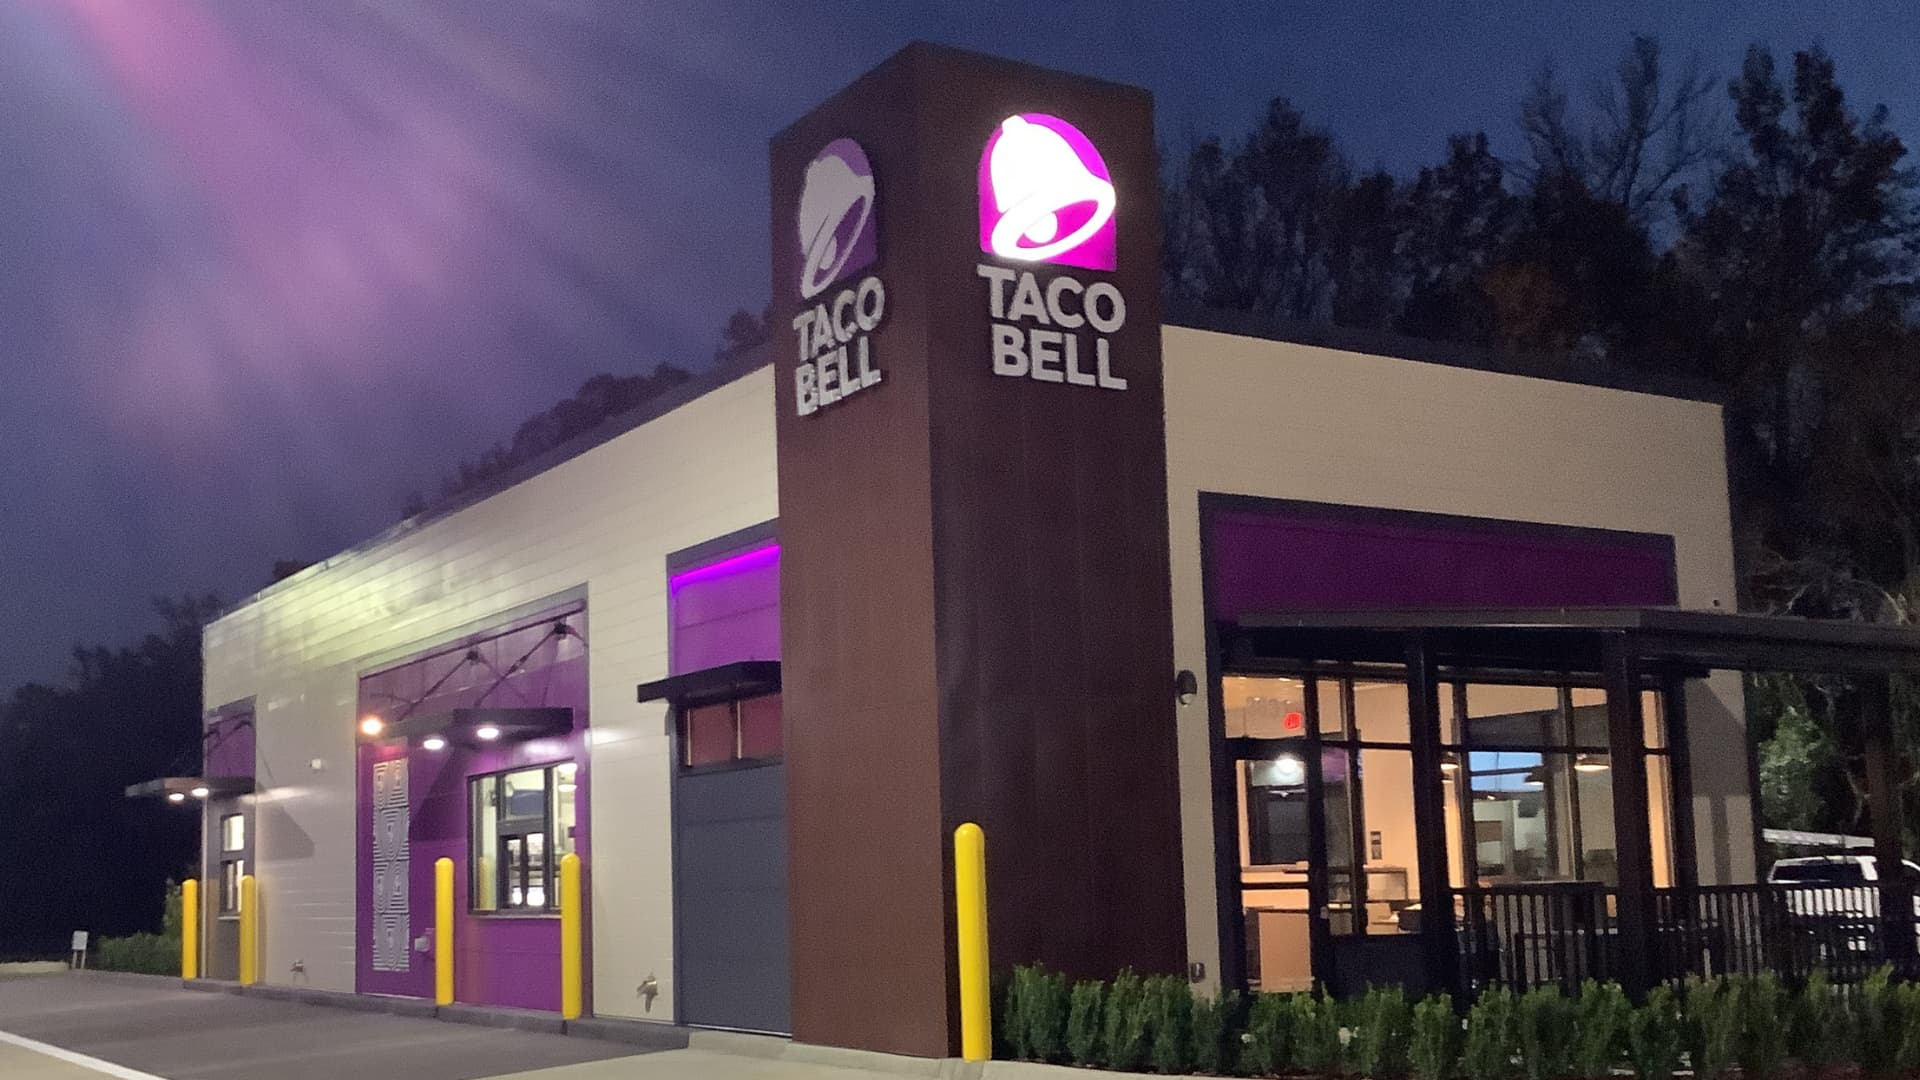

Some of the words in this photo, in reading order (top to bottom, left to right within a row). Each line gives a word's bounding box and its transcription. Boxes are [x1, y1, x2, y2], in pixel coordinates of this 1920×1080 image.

[793, 276, 885, 361] TACO
[977, 264, 1126, 333] TACO
[796, 336, 881, 416] BELL
[992, 323, 1127, 390] BELL
